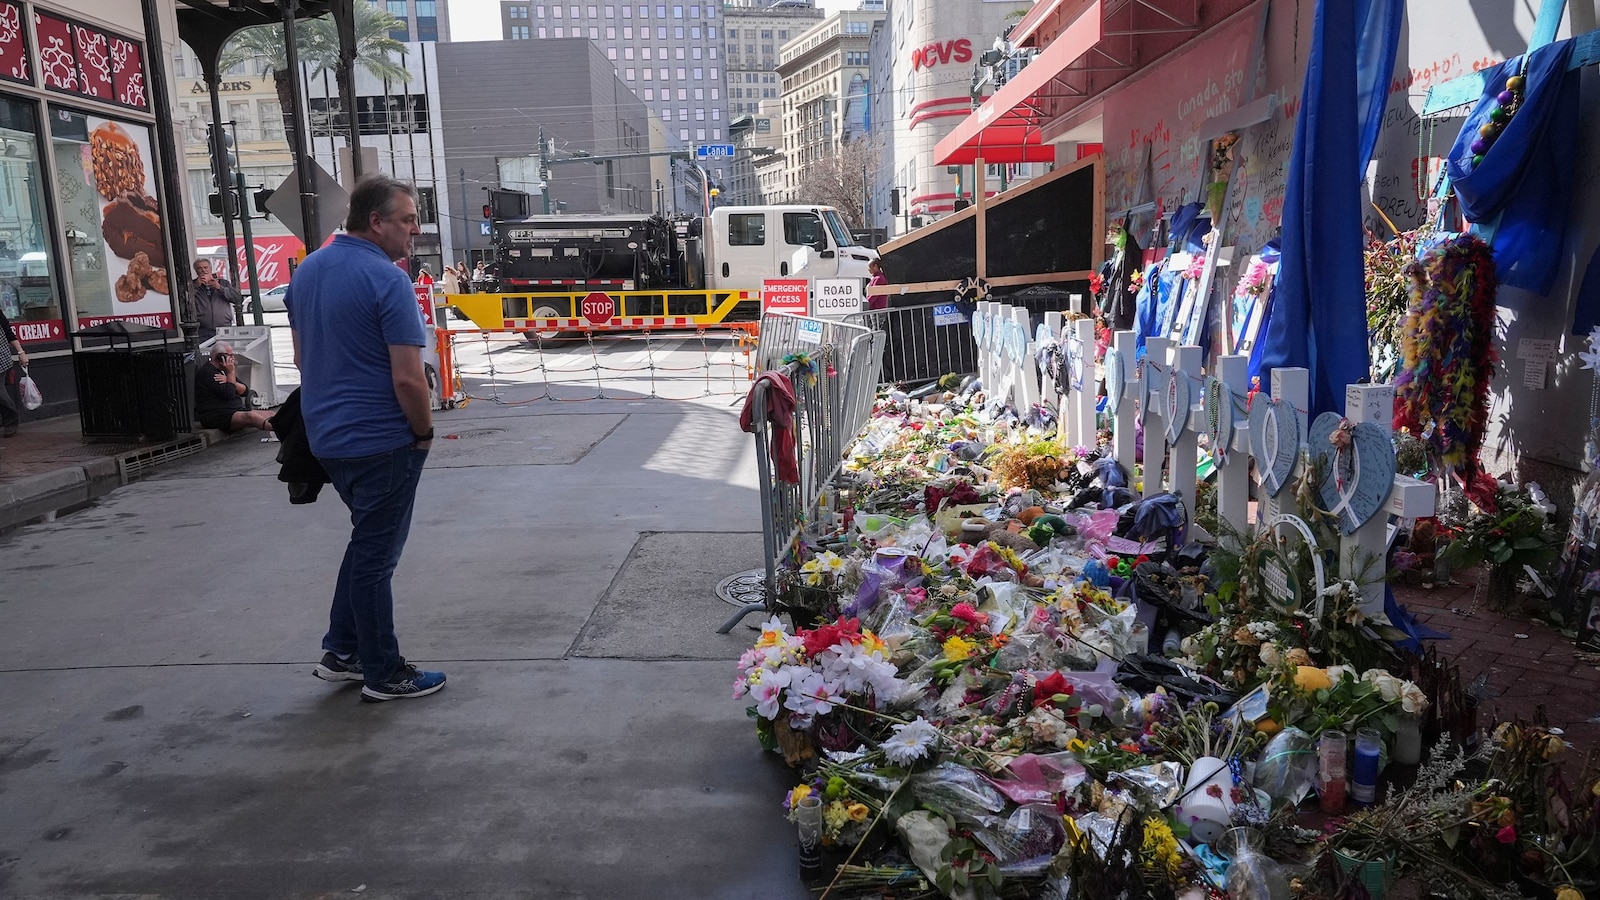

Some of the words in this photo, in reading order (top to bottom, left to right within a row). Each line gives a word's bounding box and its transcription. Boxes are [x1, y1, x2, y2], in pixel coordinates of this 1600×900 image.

[921, 38, 973, 68] CVS
[706, 146, 728, 155] Canal
[1378, 196, 1418, 219] DREW
[823, 286, 852, 295] ROAD
[954, 276, 992, 297] EMS
[771, 295, 801, 303] ACCESS
[818, 298, 858, 308] CLOSED
[583, 302, 612, 314] STOP
[19, 323, 50, 341] CREAM
